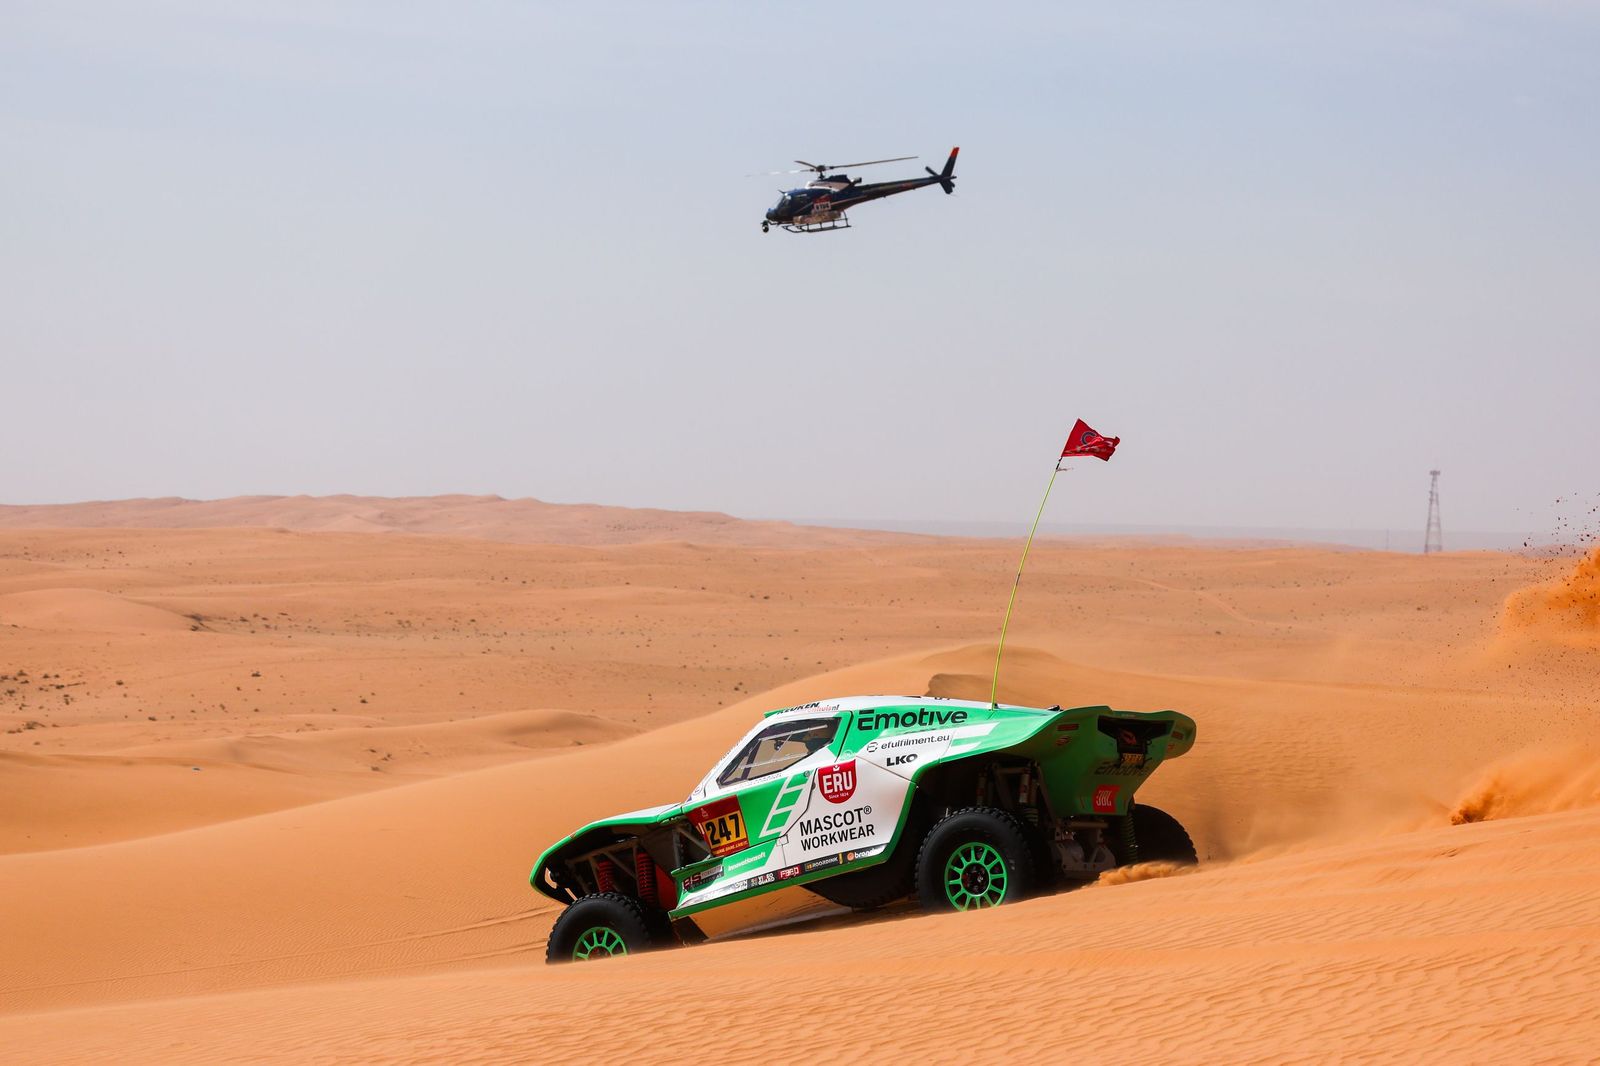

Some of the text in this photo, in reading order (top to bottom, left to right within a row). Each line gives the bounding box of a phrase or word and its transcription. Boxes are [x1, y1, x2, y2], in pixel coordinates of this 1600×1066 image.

[857, 708, 968, 731] Emotive
[881, 735, 950, 750] efulfilment.eu
[886, 753, 918, 767] LKO
[822, 771, 853, 794] ERU
[705, 813, 740, 846] 247
[800, 824, 875, 852] WORKWEAR
